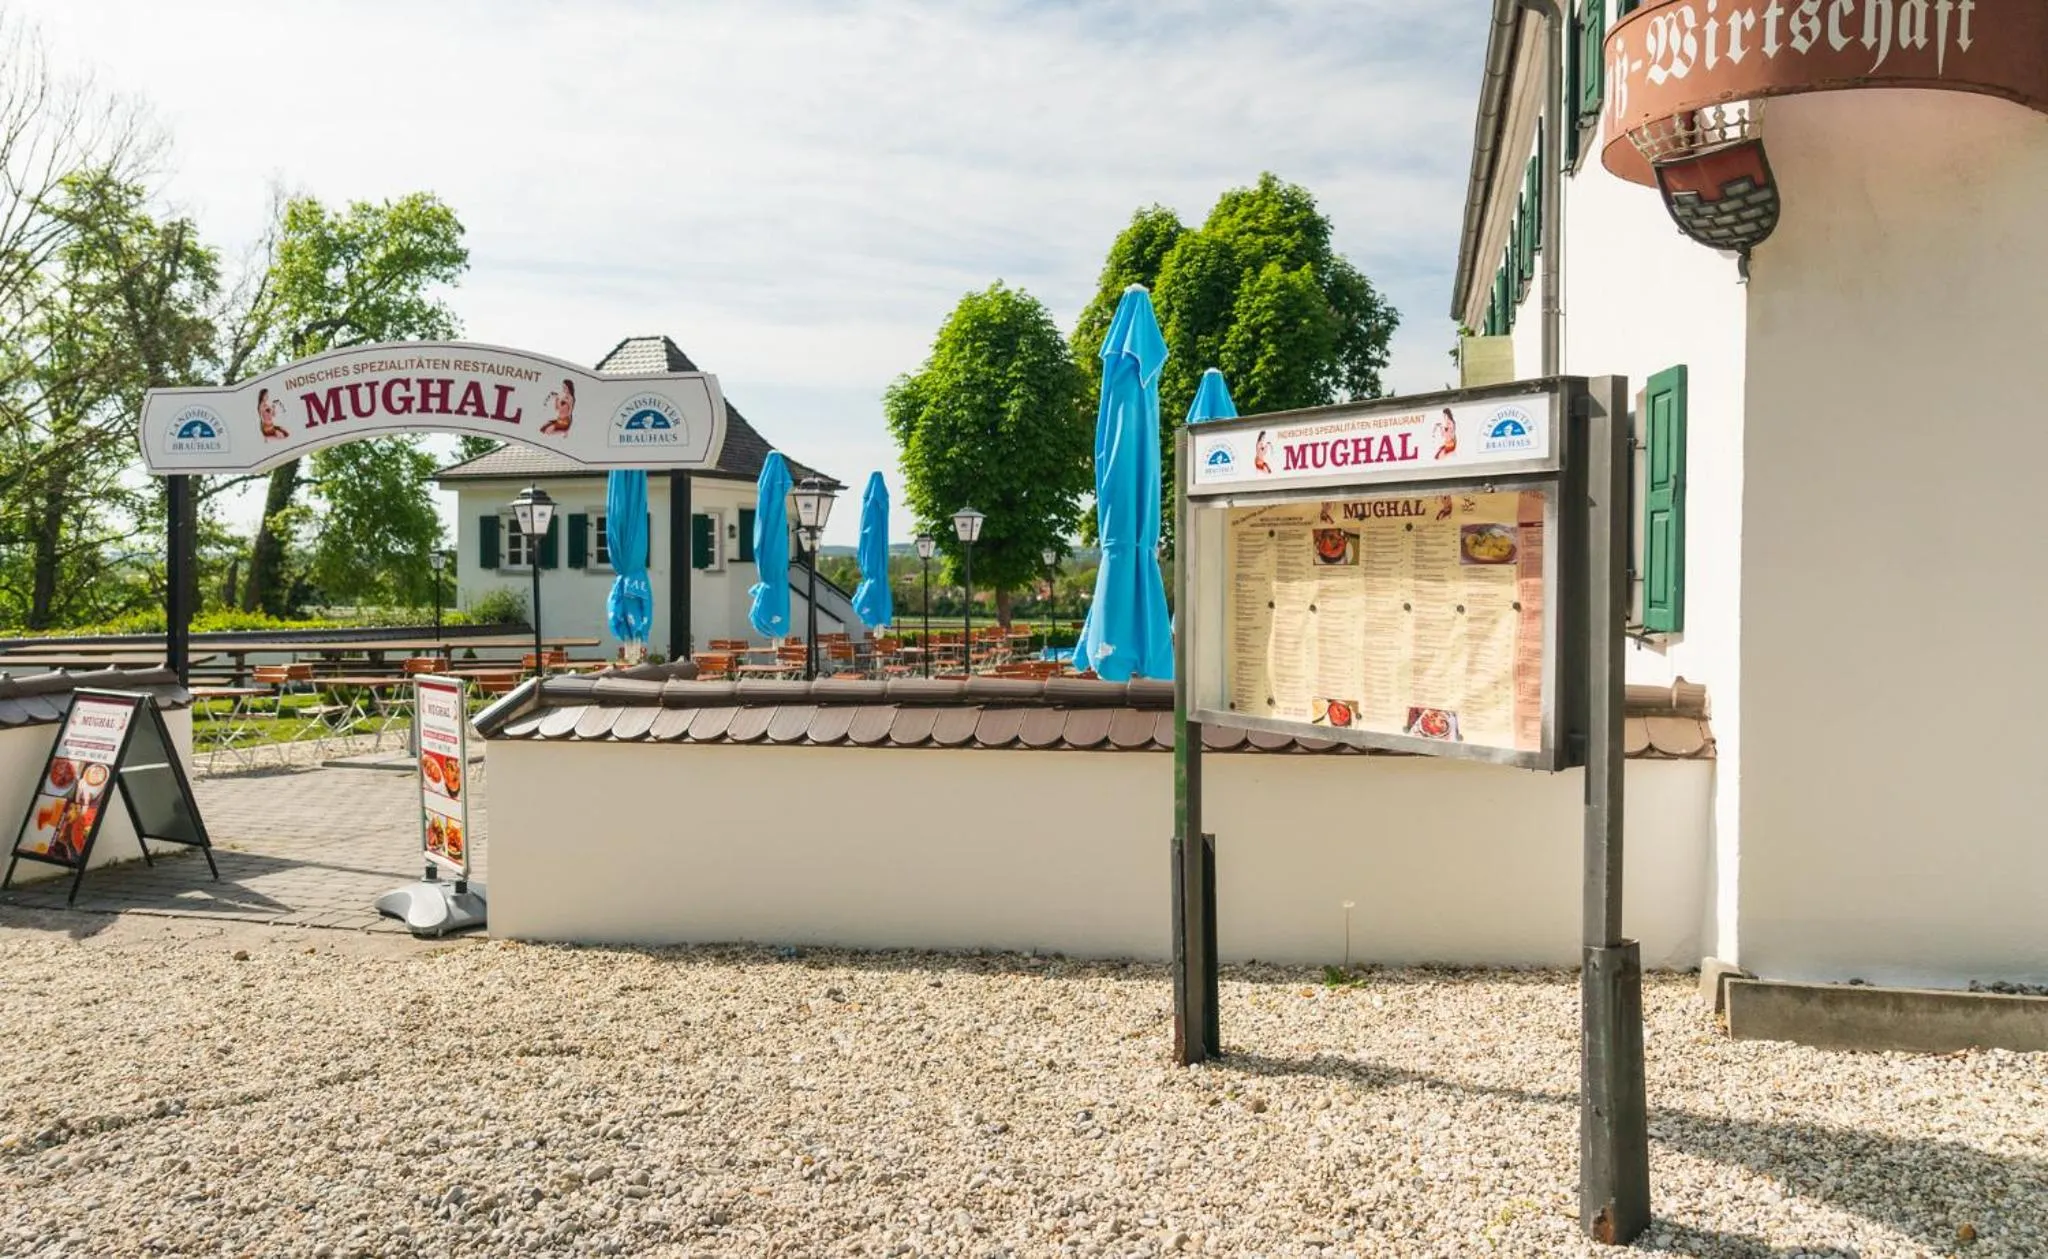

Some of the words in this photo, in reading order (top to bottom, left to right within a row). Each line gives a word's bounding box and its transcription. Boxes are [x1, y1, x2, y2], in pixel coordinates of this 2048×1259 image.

[285, 365, 350, 391] INDISCHES
[352, 358, 453, 375] SPEZIALITÄTEN
[454, 359, 542, 383] RESTAURANT
[300, 377, 523, 429] MUGHAL
[614, 397, 681, 428] LANDSHUTER
[619, 432, 678, 444] BRAUHAUS
[1283, 432, 1418, 471] MUGHAL
[1343, 499, 1426, 520] MUGHAL
